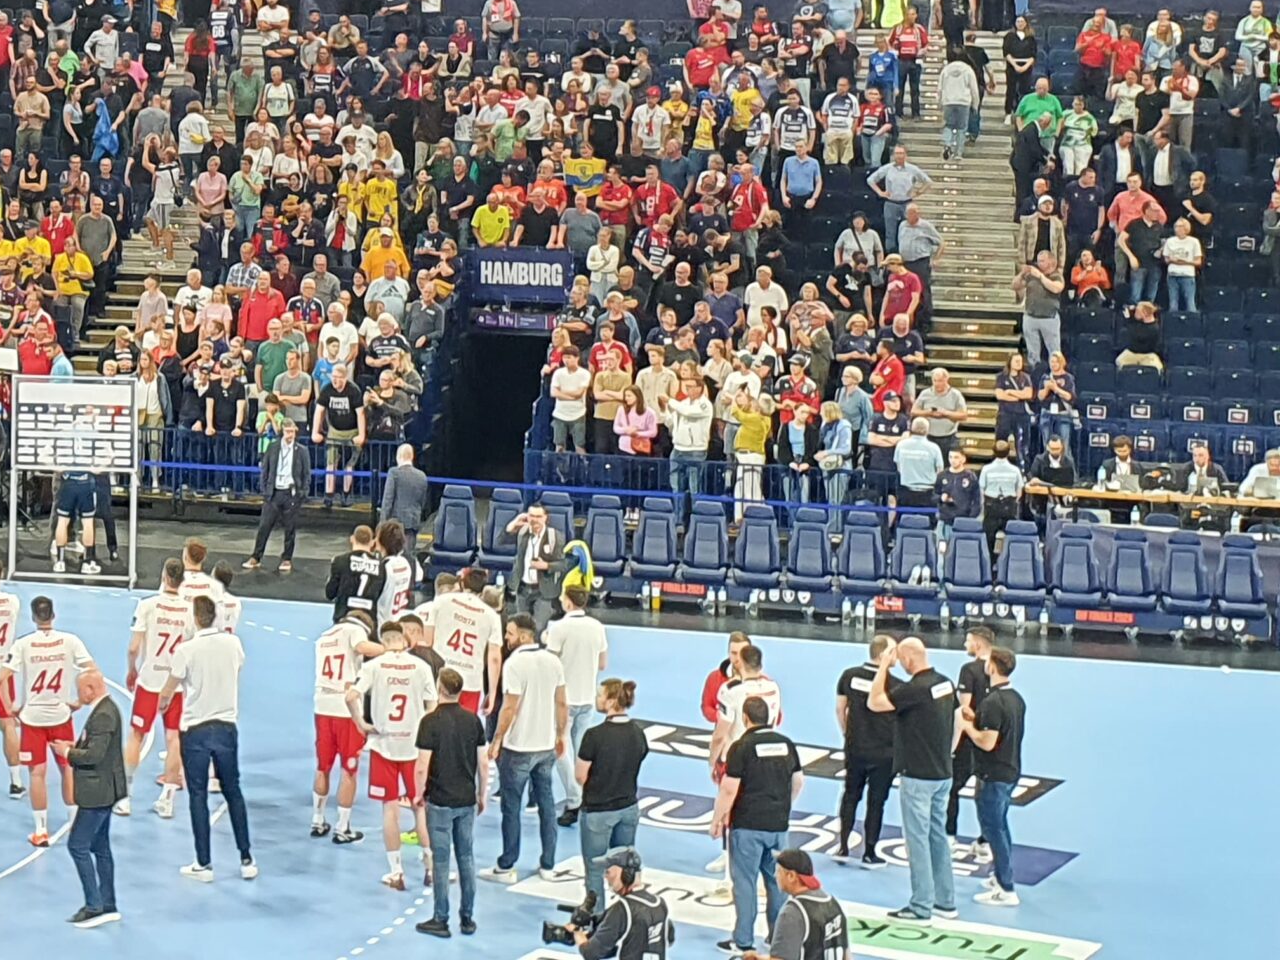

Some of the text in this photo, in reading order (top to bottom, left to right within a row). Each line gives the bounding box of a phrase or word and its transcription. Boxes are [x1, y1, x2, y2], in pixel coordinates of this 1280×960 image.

[480, 260, 564, 286] HAMBURG
[356, 574, 369, 596] 1
[447, 628, 478, 656] 45
[322, 653, 345, 680] 47
[30, 668, 63, 694] 44
[388, 694, 407, 722] 3
